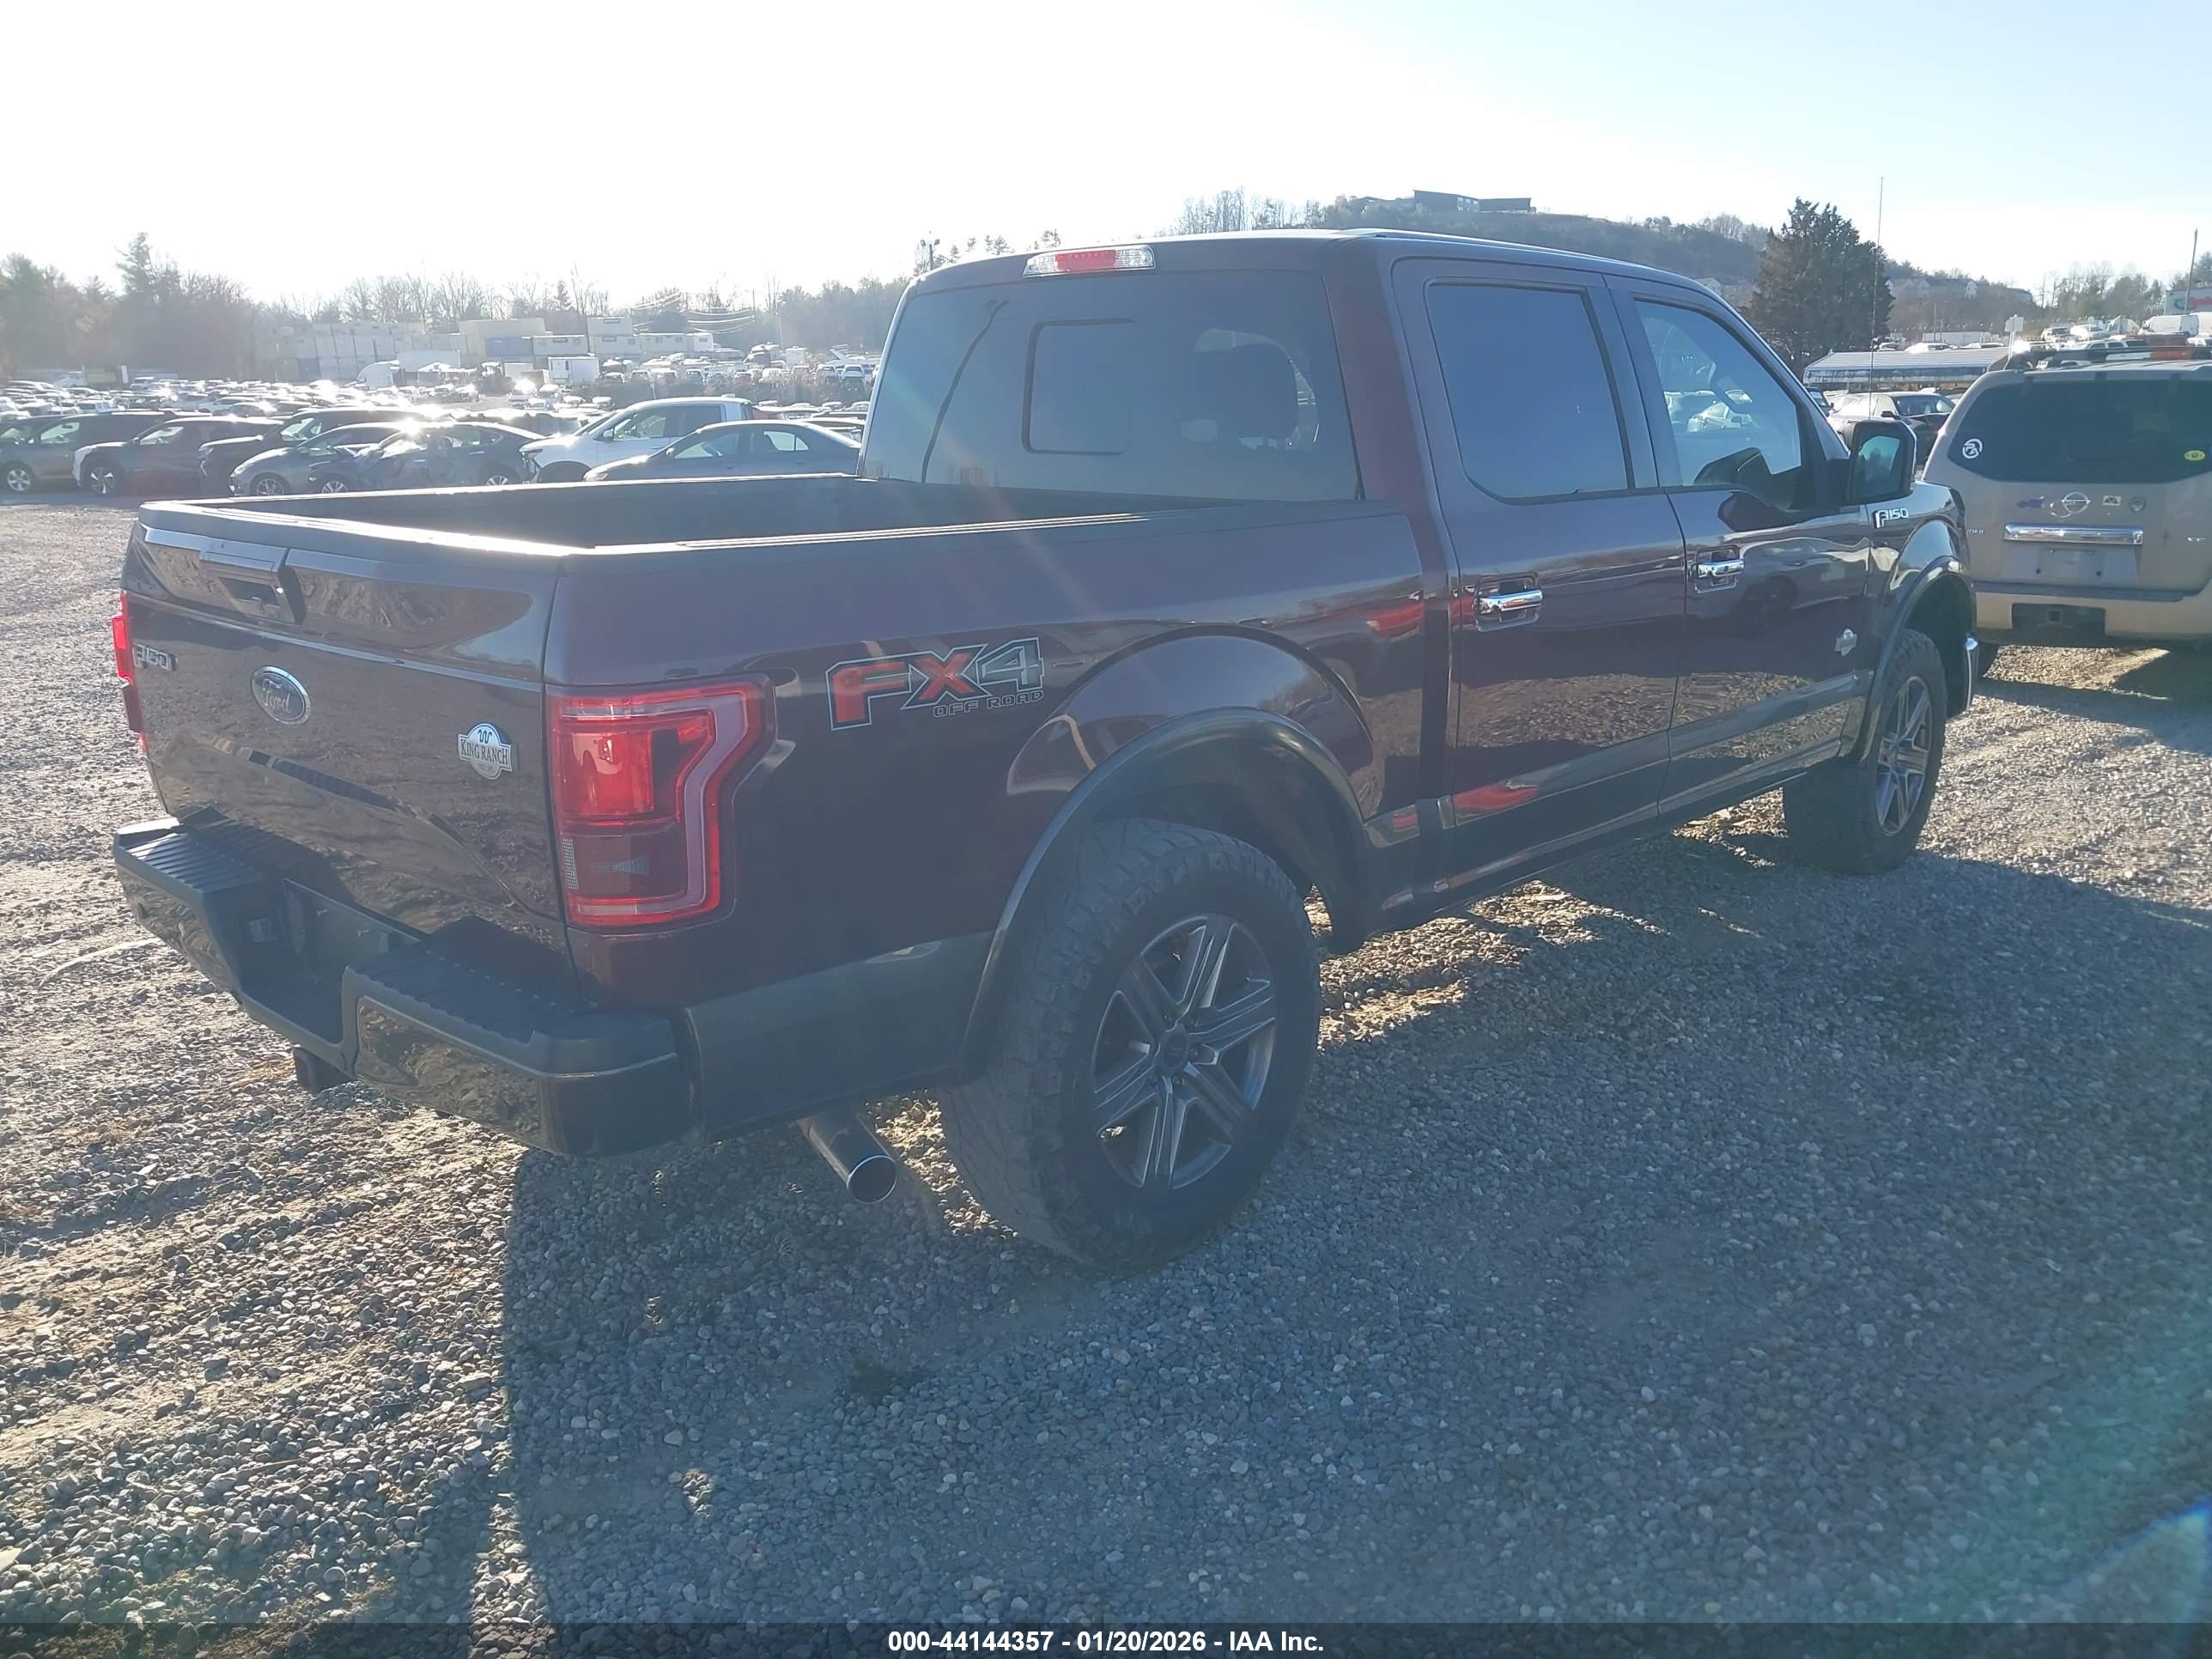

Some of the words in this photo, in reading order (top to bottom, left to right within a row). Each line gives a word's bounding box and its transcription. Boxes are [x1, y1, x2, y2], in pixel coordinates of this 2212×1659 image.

[261, 678, 291, 714] Ford
[825, 637, 1045, 731] FX4
[933, 701, 979, 718] OFF
[987, 690, 1044, 709] ROAD
[460, 738, 480, 760] KING
[481, 745, 509, 765] RANCH
